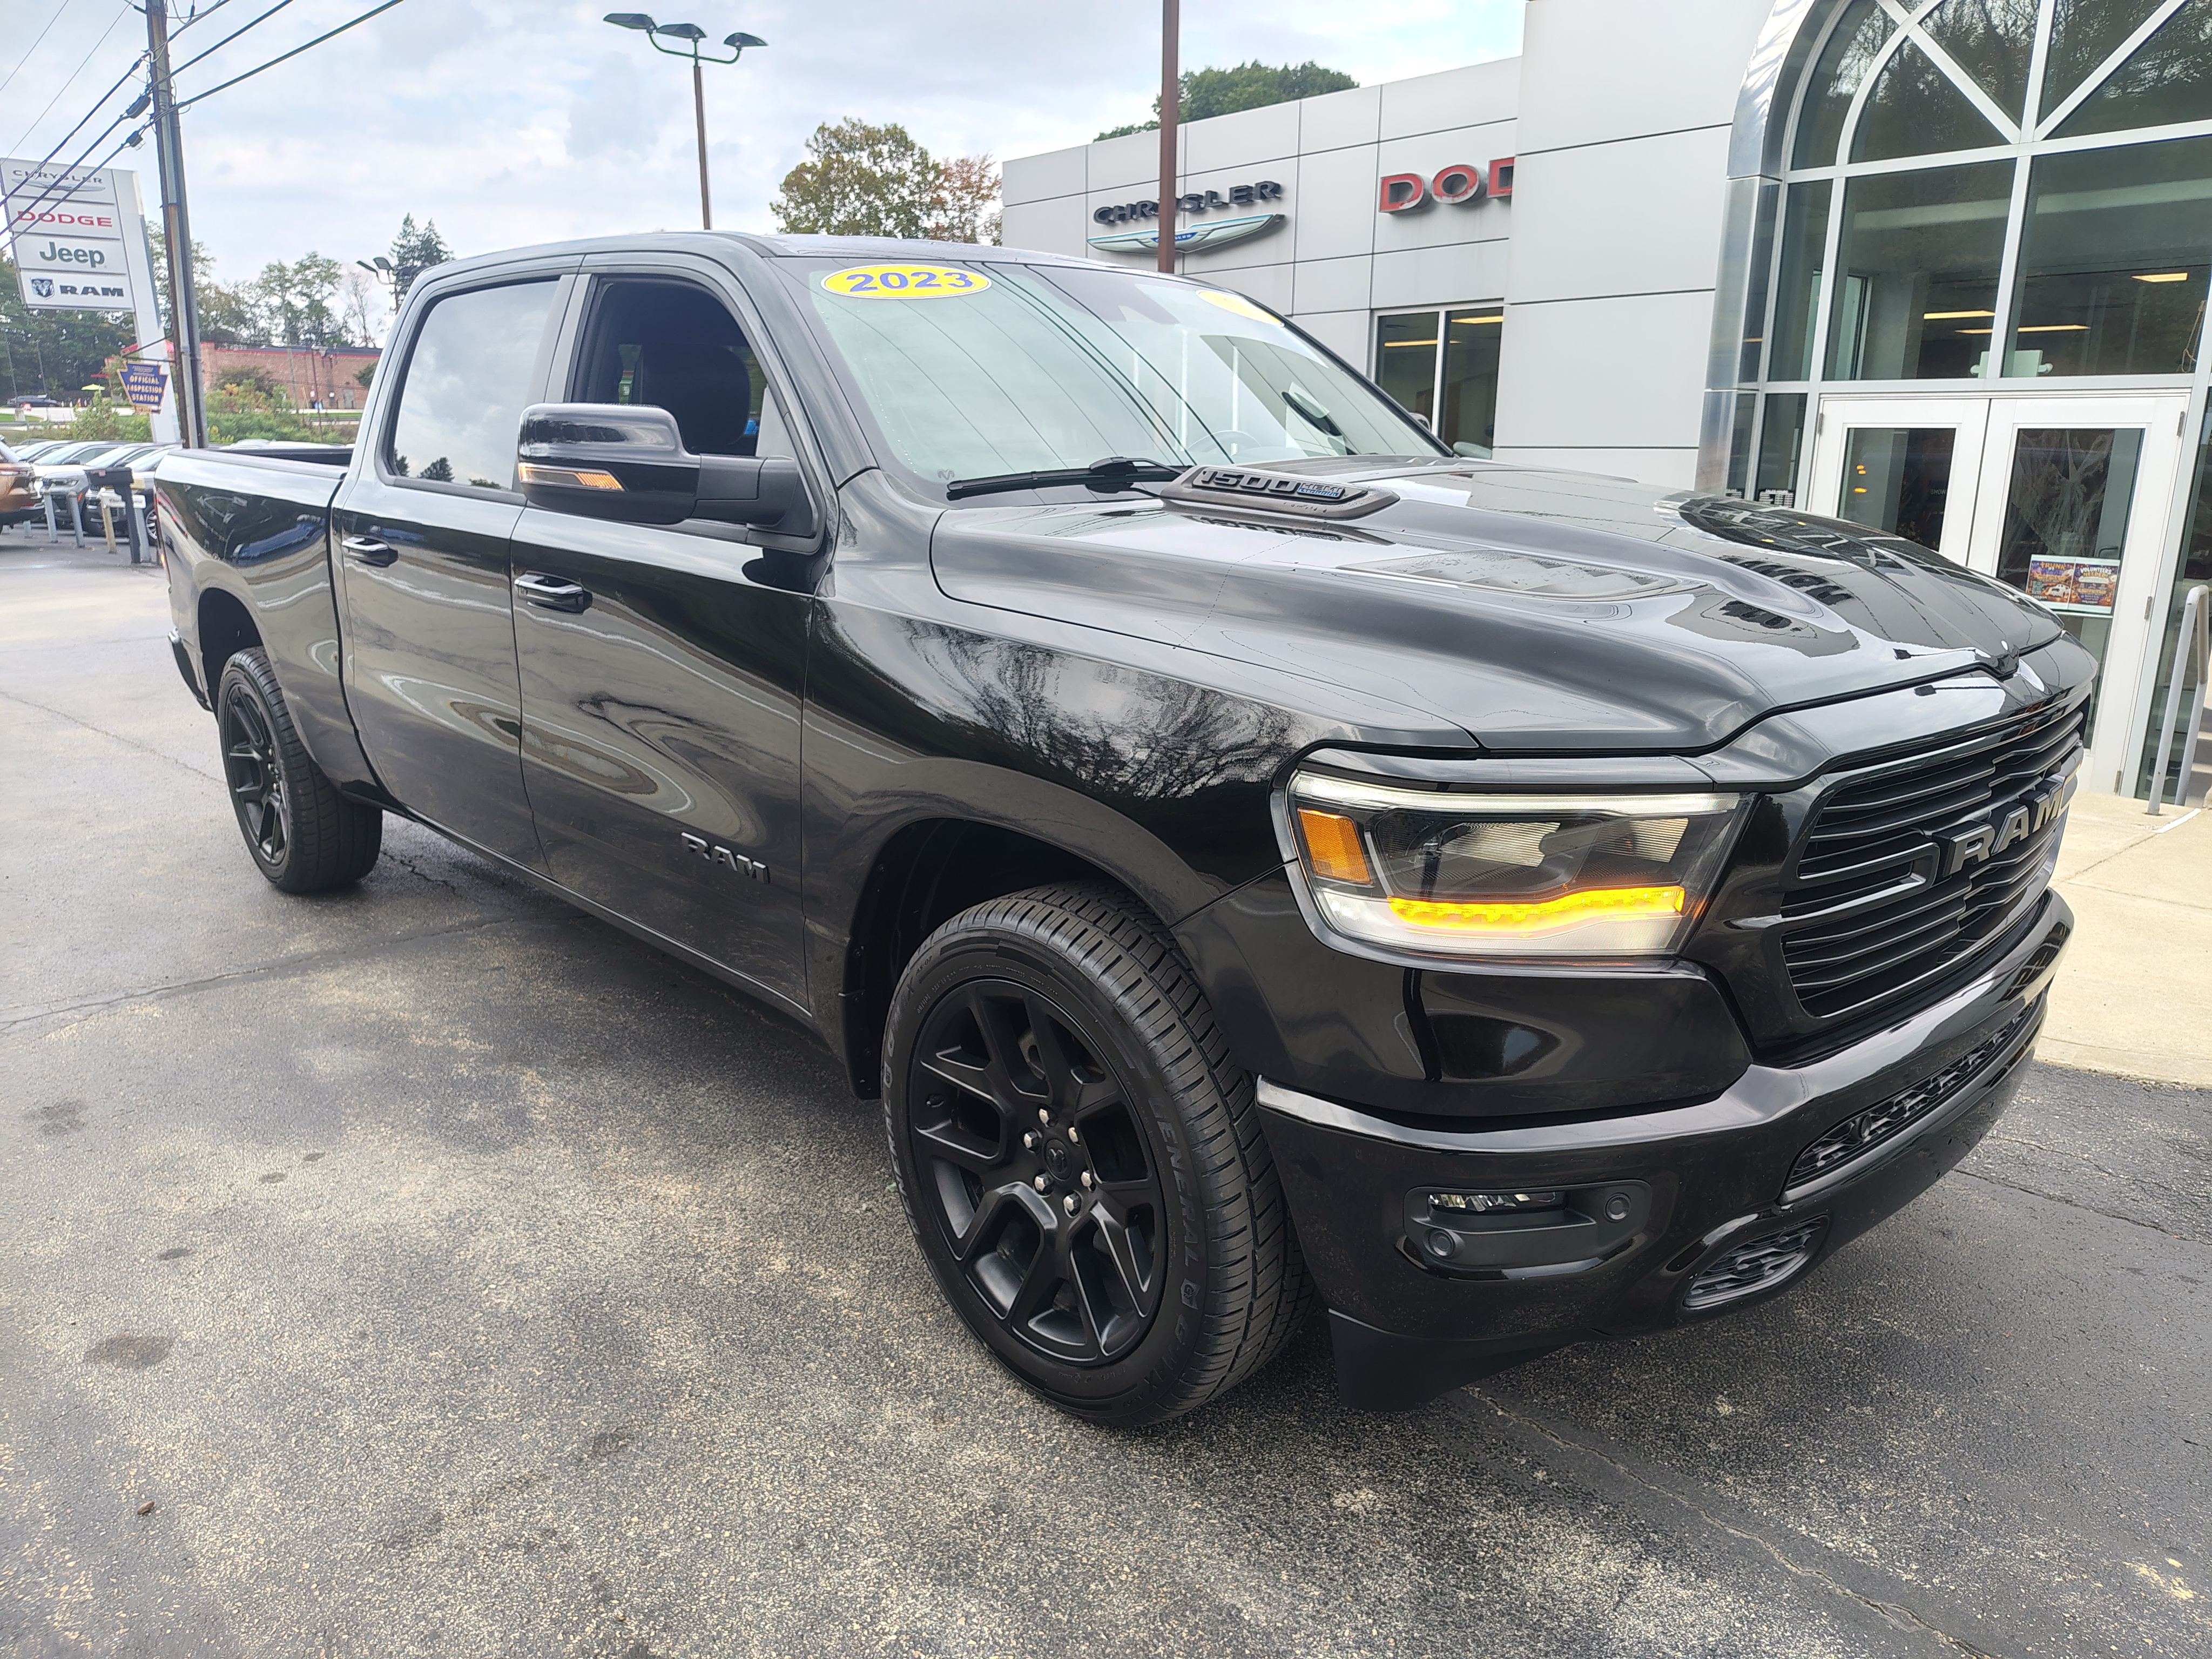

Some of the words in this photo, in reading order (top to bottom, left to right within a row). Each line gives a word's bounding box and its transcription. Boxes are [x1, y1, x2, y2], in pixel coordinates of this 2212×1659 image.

[1094, 180, 1284, 225] CHRSLER
[17, 210, 113, 227] DODGE
[39, 241, 105, 268] Jeep
[59, 284, 124, 298] RAM
[846, 272, 973, 292] 2023
[127, 384, 163, 394] INSPECTION
[130, 375, 159, 385] OFFICIAL
[131, 394, 159, 402] STATION
[1202, 470, 1300, 494] 1500
[2080, 567, 2112, 575] VOLUNTEERS
[1946, 781, 2064, 875] RAM
[681, 832, 771, 884] RAM
[1148, 1096, 1199, 1269] GENERAL
